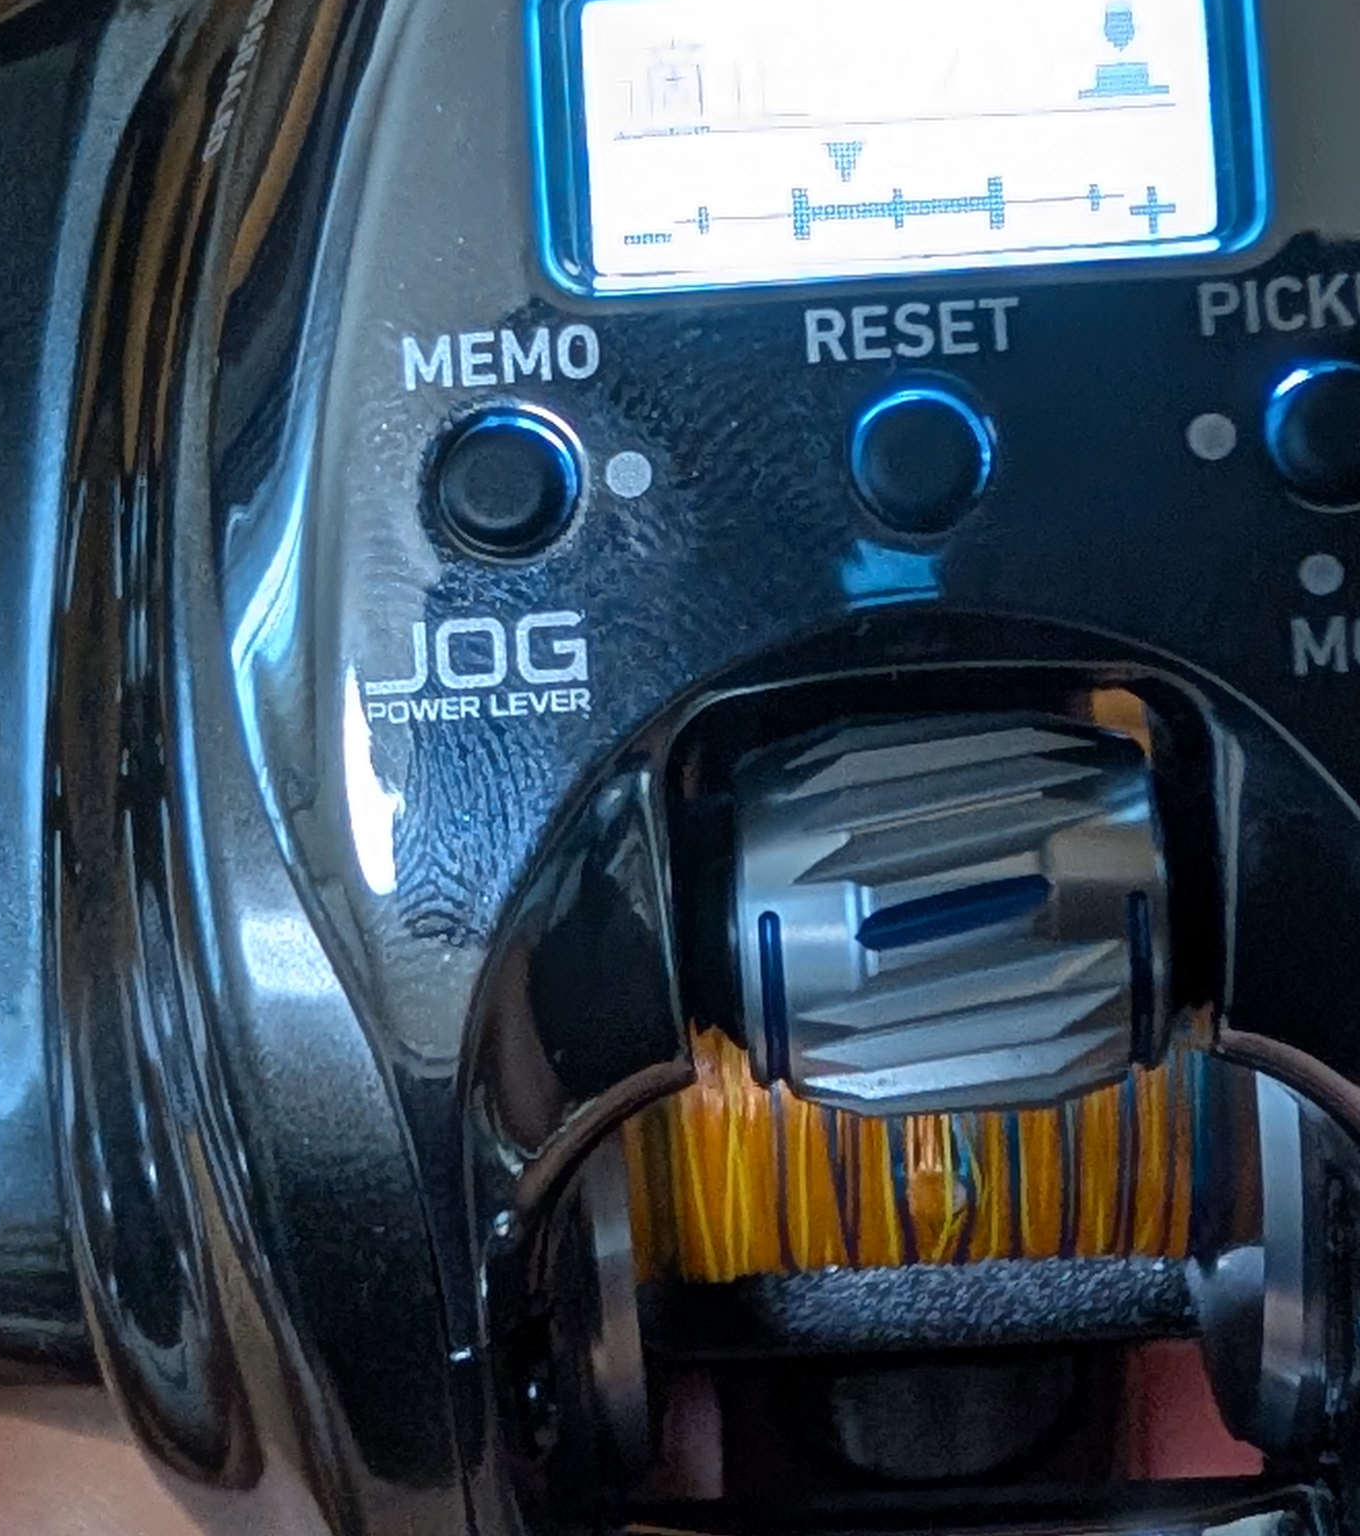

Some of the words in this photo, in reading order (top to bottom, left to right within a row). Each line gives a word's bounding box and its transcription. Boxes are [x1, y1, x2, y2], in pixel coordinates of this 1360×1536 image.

[401, 324, 600, 391] MEMO
[804, 297, 1018, 364] RESET
[364, 609, 589, 695] JOG
[366, 695, 480, 724] POWER
[489, 687, 592, 718] LEVER
